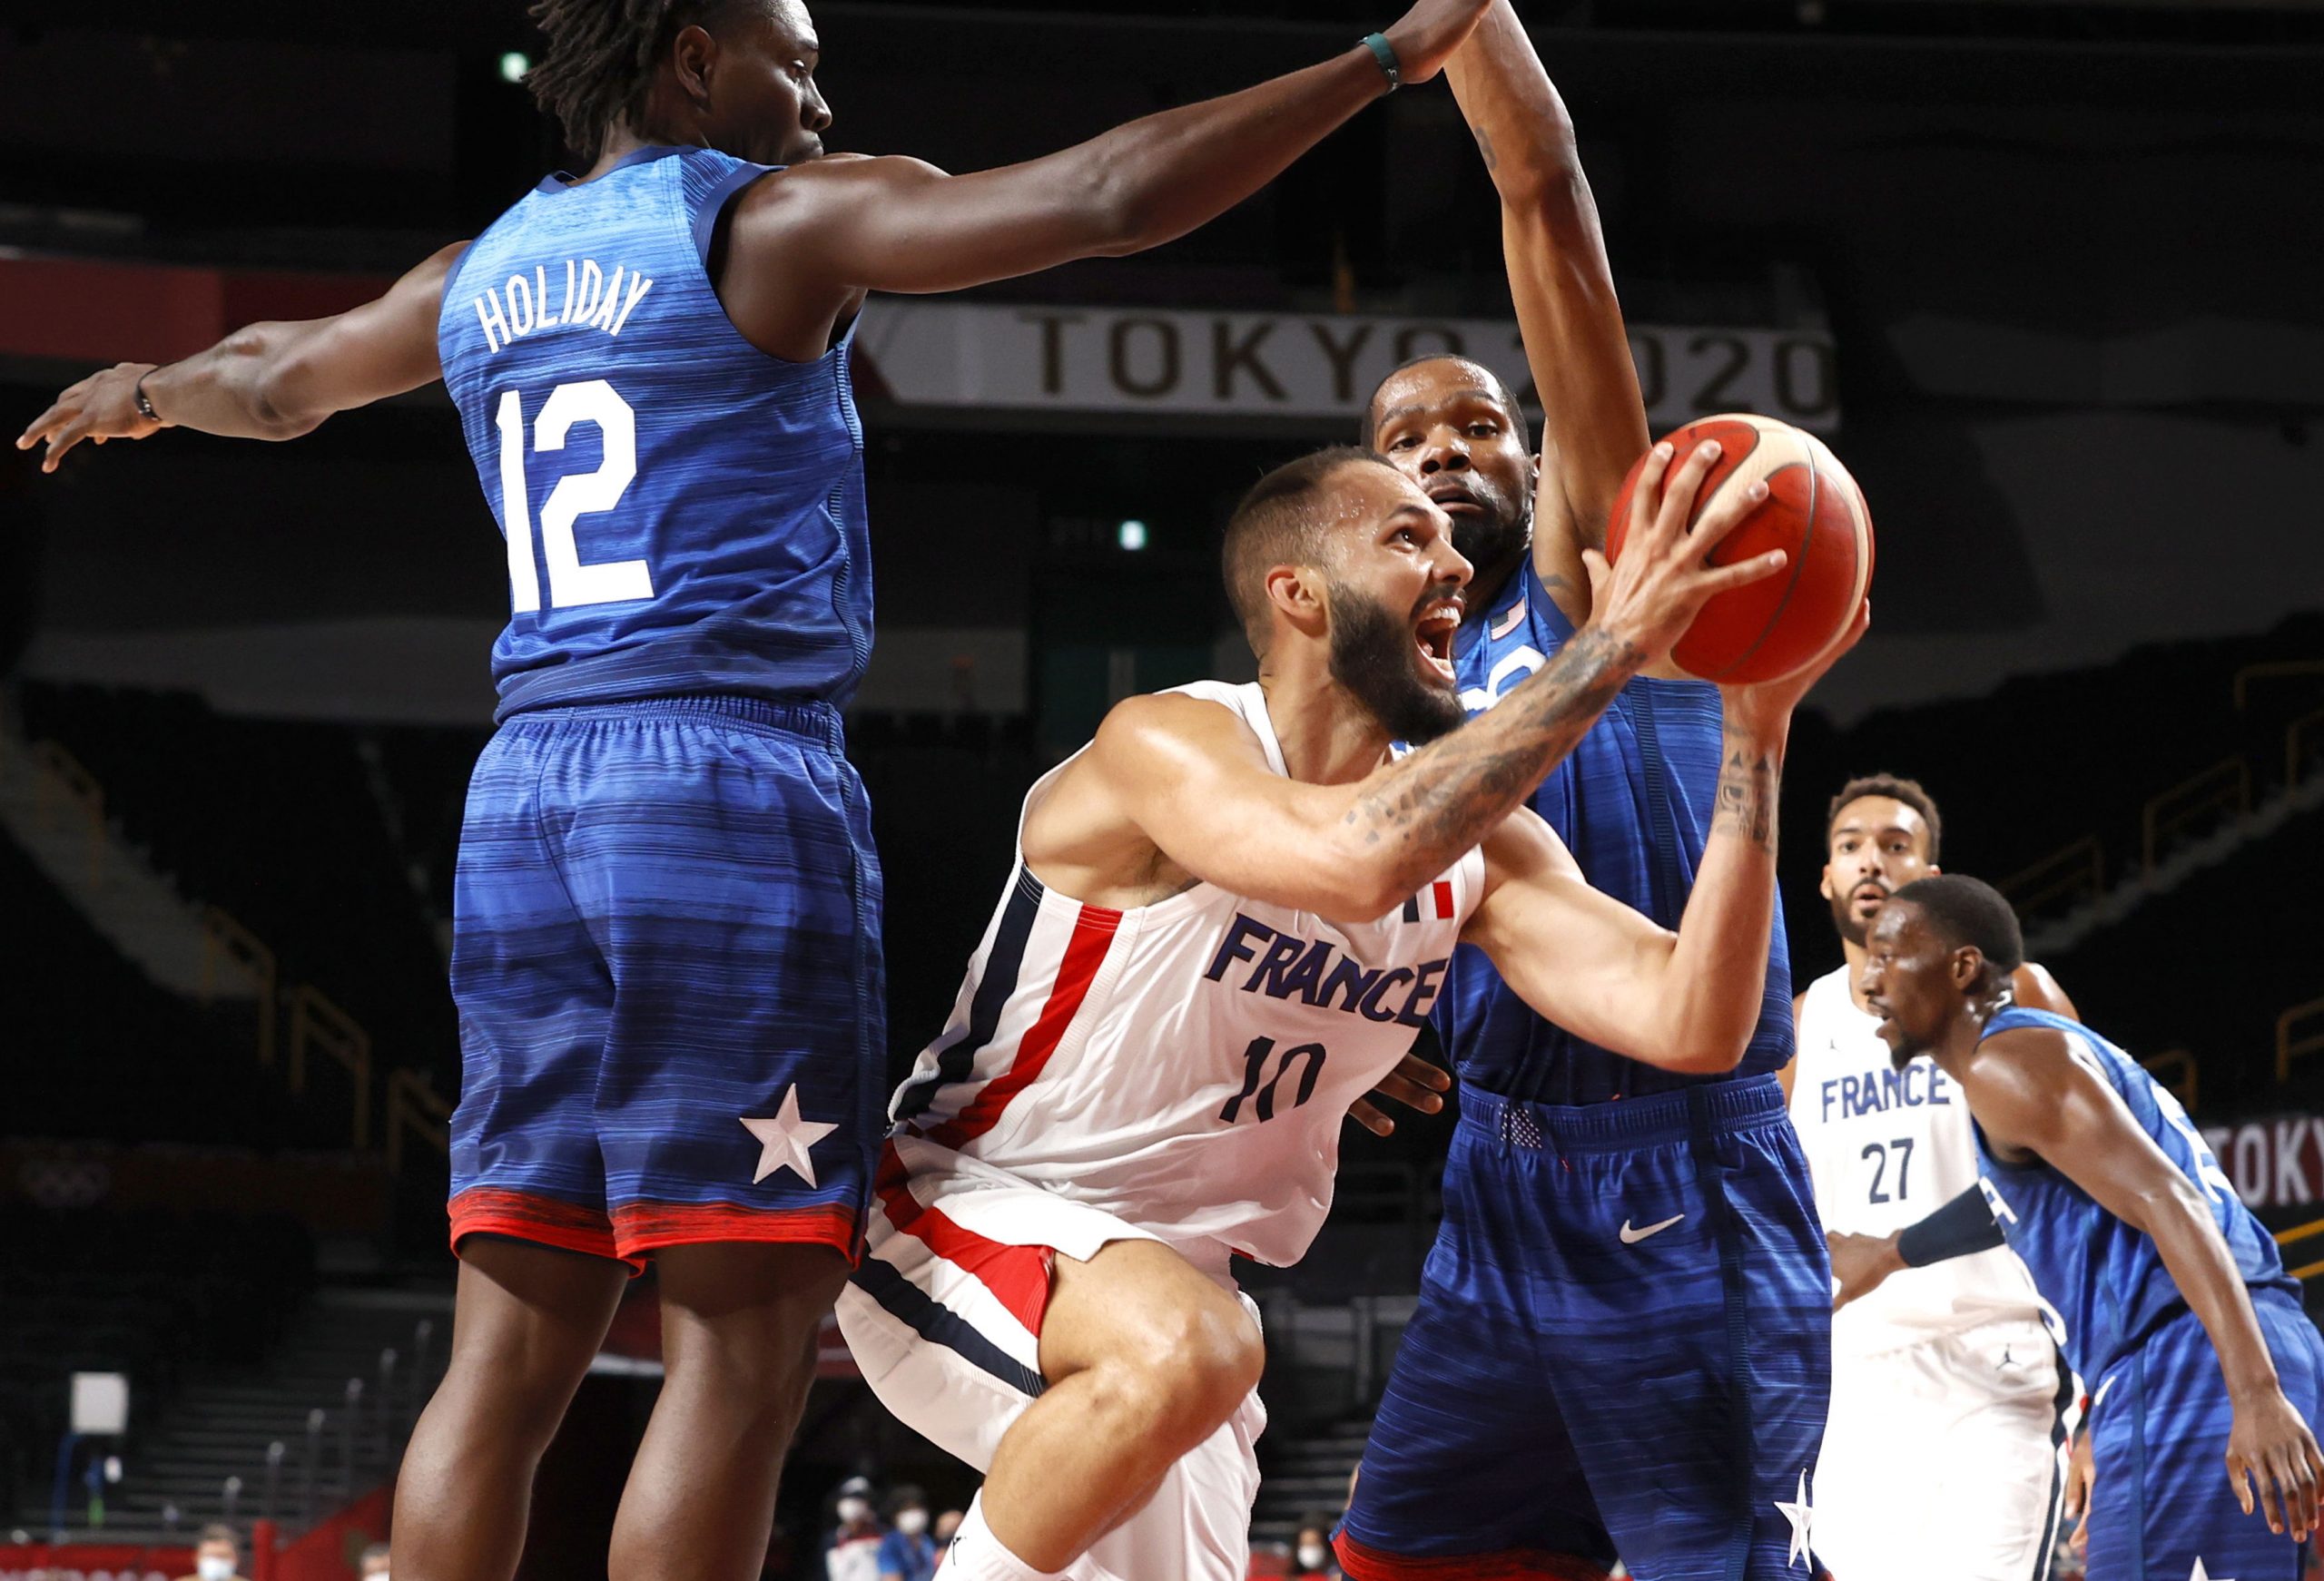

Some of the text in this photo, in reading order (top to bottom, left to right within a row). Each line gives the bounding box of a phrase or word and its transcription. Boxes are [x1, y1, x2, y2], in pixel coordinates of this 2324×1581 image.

[475, 259, 654, 353] HOLIDAY
[496, 378, 655, 614] 12
[1204, 912, 1449, 1028] FRANCE
[1219, 1036, 1326, 1124] 10
[1821, 1063, 1951, 1124] FRANCE
[1861, 1137, 1915, 1204] 27
[2201, 1118, 2324, 1208] TOK
